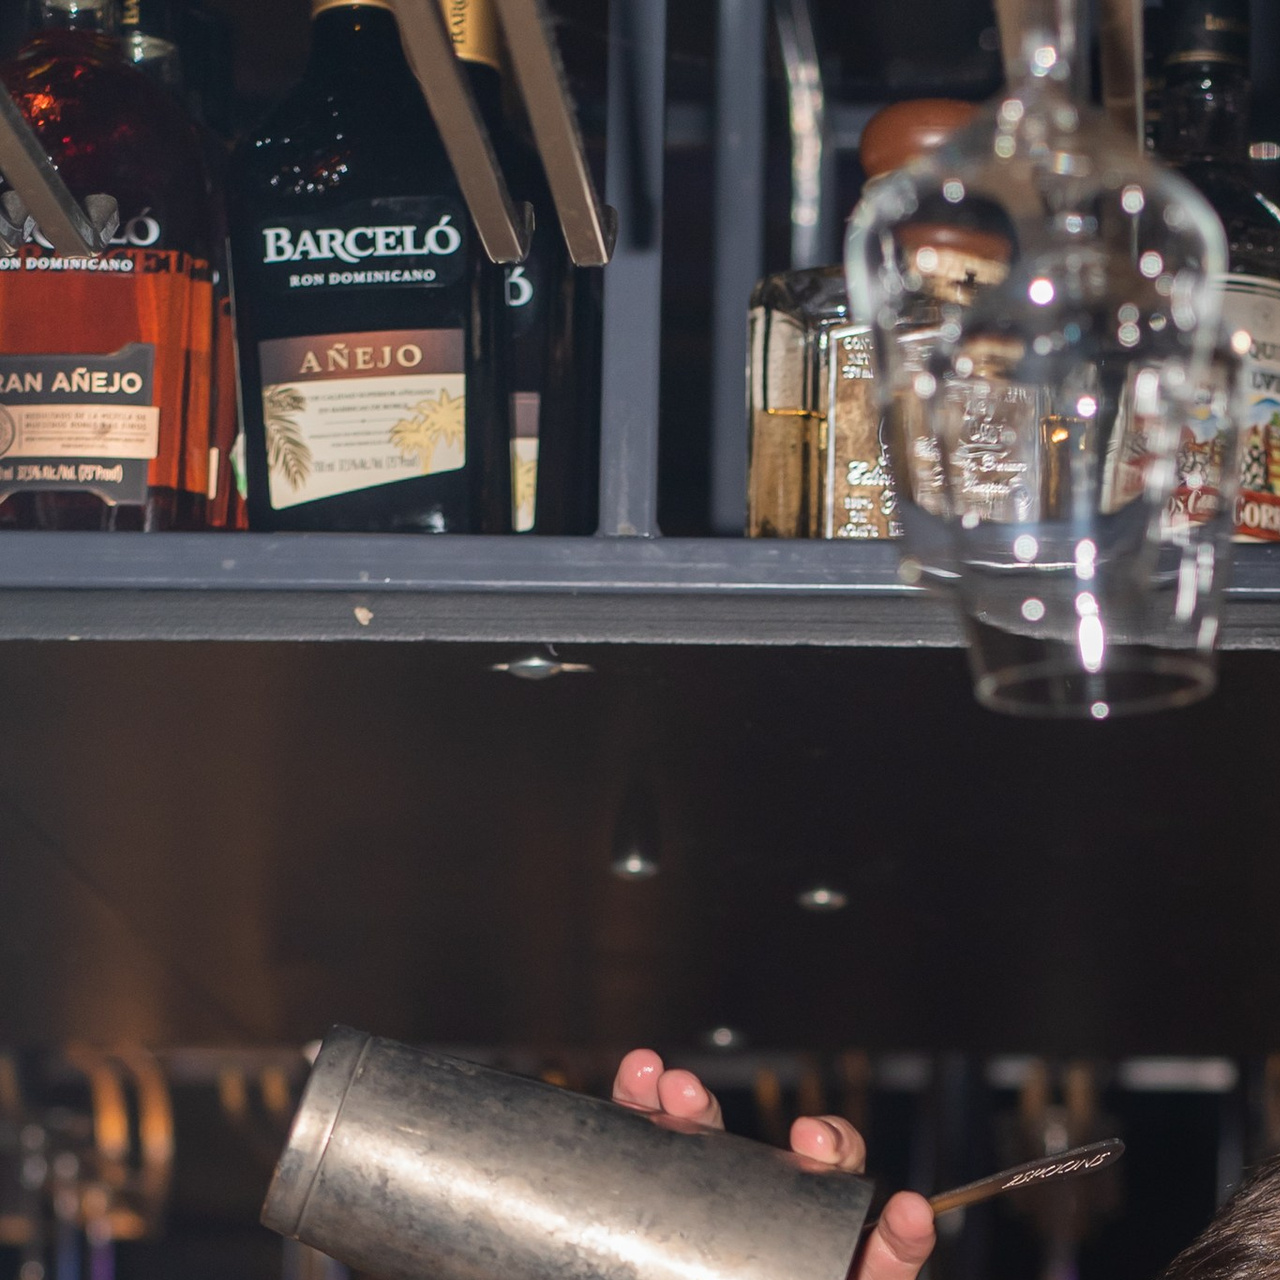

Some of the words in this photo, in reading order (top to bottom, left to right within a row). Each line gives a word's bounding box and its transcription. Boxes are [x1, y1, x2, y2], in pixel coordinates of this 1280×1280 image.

[262, 215, 461, 264] BARCELÓ
[0, 257, 21, 271] ON
[25, 257, 134, 272] DOMINICANO
[290, 273, 325, 288] RON
[328, 269, 437, 286] DOMINICANO
[300, 343, 423, 374] AÑEJO
[51, 367, 143, 395] AÑEJO
